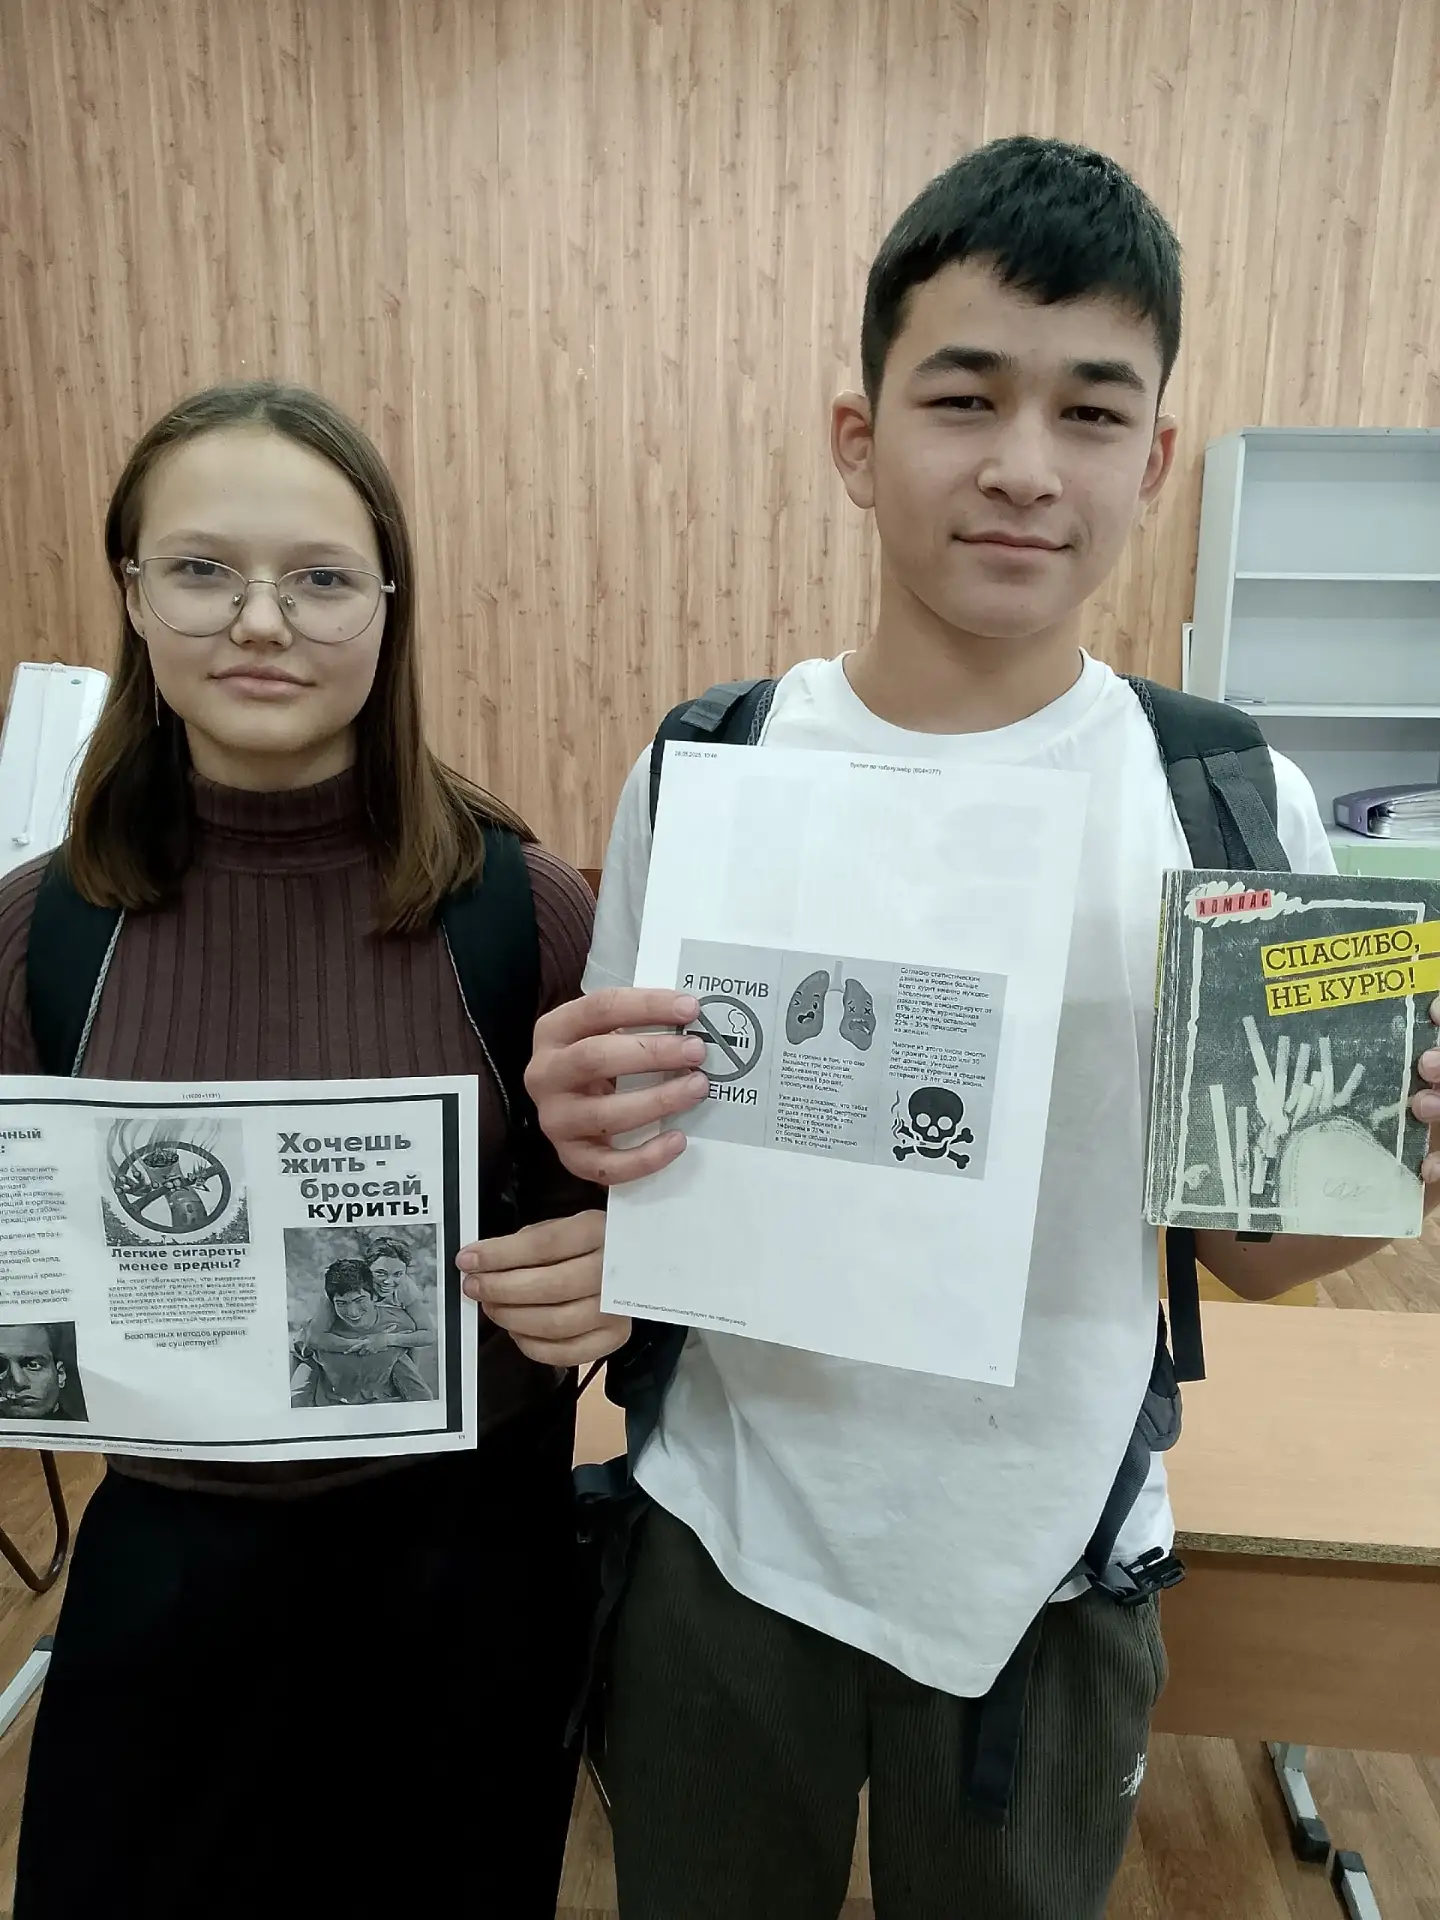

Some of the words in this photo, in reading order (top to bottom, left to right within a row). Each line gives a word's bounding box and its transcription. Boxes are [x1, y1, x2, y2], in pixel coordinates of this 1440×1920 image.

[1265, 929, 1421, 970] СПАСИБО,
[683, 974, 693, 989] Я
[699, 976, 769, 998] ПРОТИВ
[1272, 983, 1312, 1010] НЕ
[1320, 967, 1415, 1006] КУРЮ!
[708, 1084, 757, 1106] ЕНИЯ
[277, 1132, 412, 1154] Хочешь
[281, 1156, 366, 1174] жить
[300, 1174, 422, 1201] бросай
[308, 1195, 429, 1223] курить!
[111, 1248, 167, 1258] Легкие
[173, 1248, 246, 1258] сигареты
[120, 1263, 168, 1271] менее
[174, 1258, 241, 1271] вредны?
